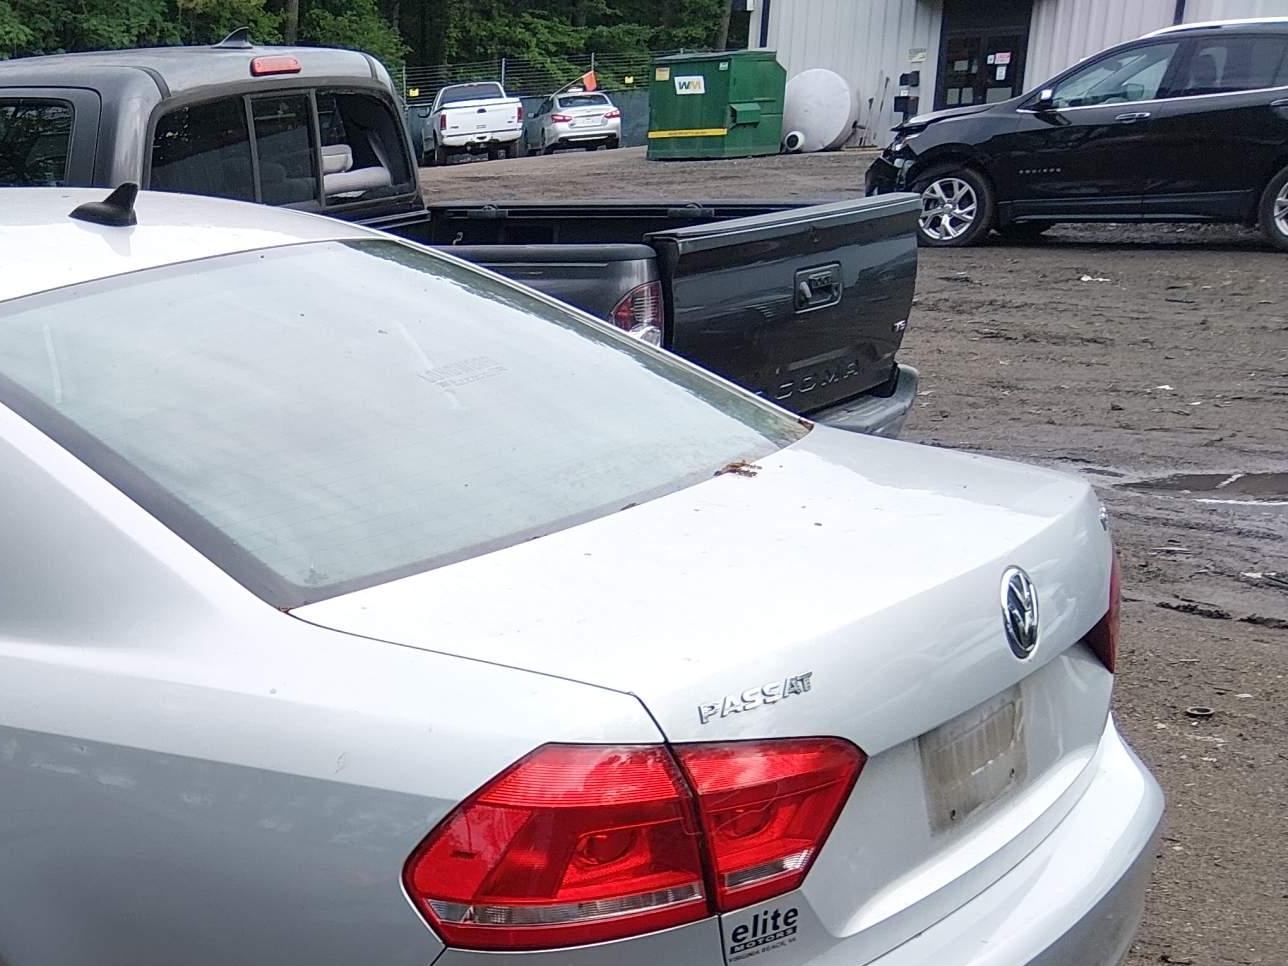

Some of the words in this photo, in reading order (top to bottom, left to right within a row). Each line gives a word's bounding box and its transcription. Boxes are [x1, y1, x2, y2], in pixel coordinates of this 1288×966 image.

[697, 671, 813, 725] PASSAT
[731, 907, 799, 943] elite
[732, 927, 795, 953] MOTORS
